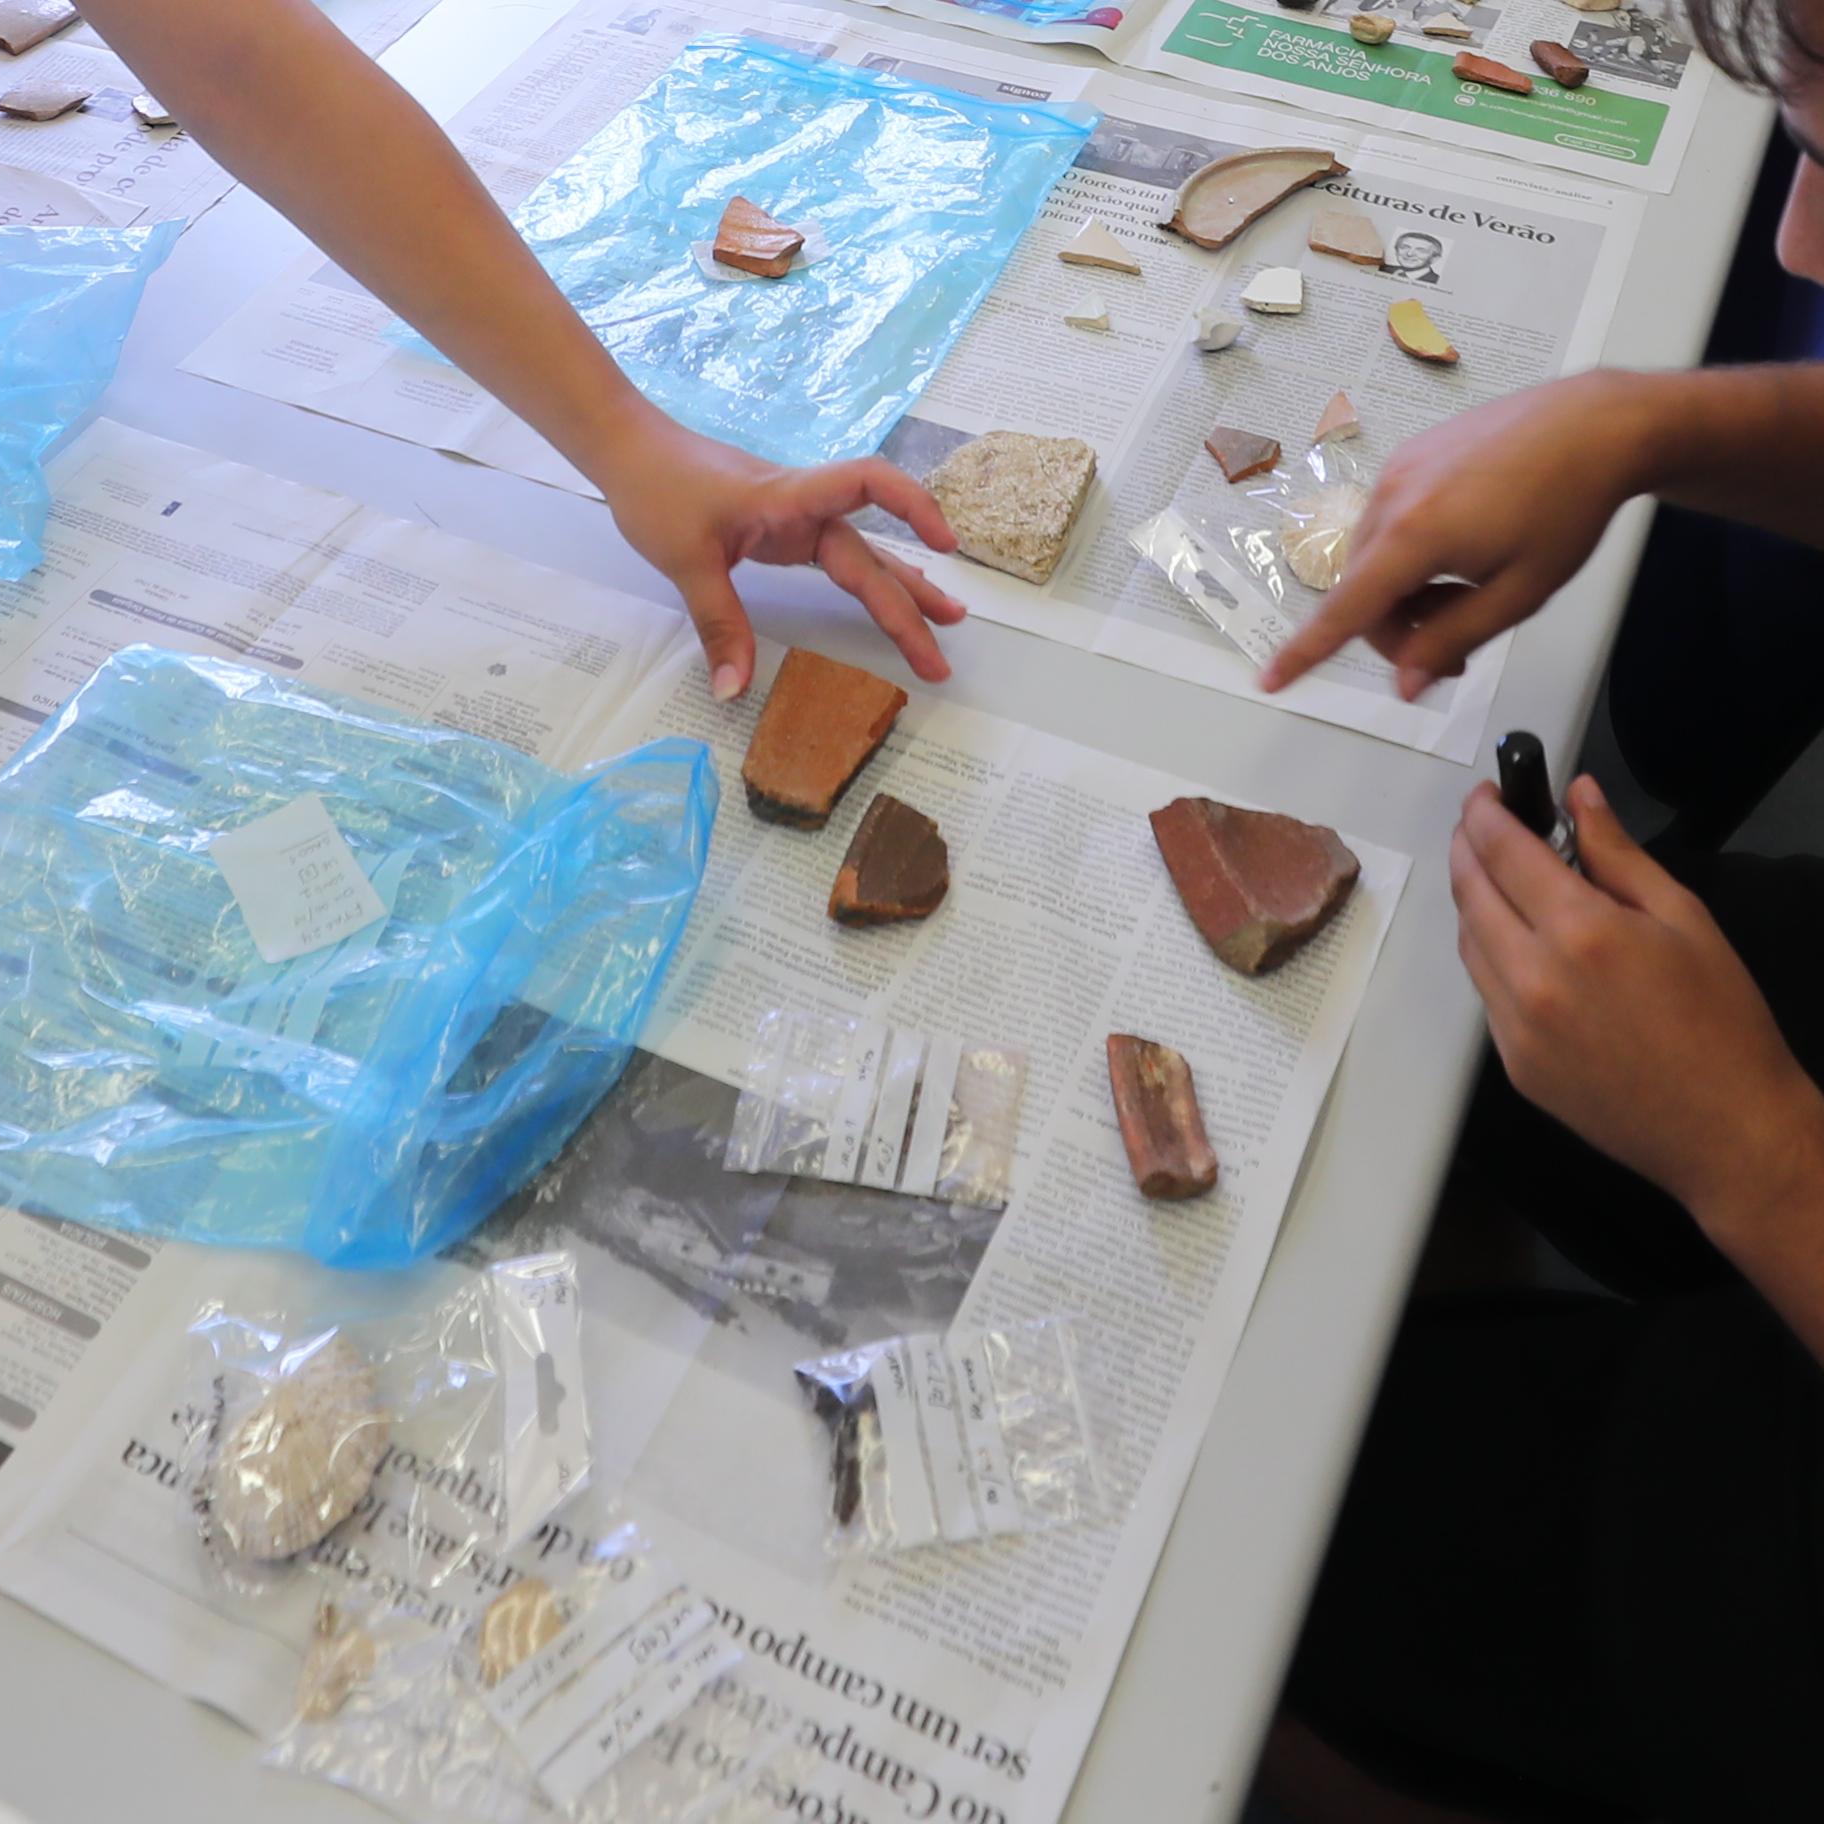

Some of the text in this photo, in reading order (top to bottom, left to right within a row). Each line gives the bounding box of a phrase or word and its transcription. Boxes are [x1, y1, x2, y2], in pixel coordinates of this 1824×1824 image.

[1262, 38, 1433, 87] NOSSA SENHORA
[1268, 28, 1367, 61] FARMÁCIA
[1256, 46, 1372, 83] DOS ANJOS
[1563, 88, 1597, 108] 890
[75, 152, 117, 187] pro
[132, 154, 162, 177] de
[1078, 173, 1117, 192] forte
[1118, 185, 1136, 196] só
[1310, 179, 1556, 245] Leituras de Verão
[0, 1282, 64, 1322] HOSPITAIS
[748, 1626, 885, 1711] campo
[888, 1690, 962, 1751] um
[963, 1731, 1030, 1783] ser
